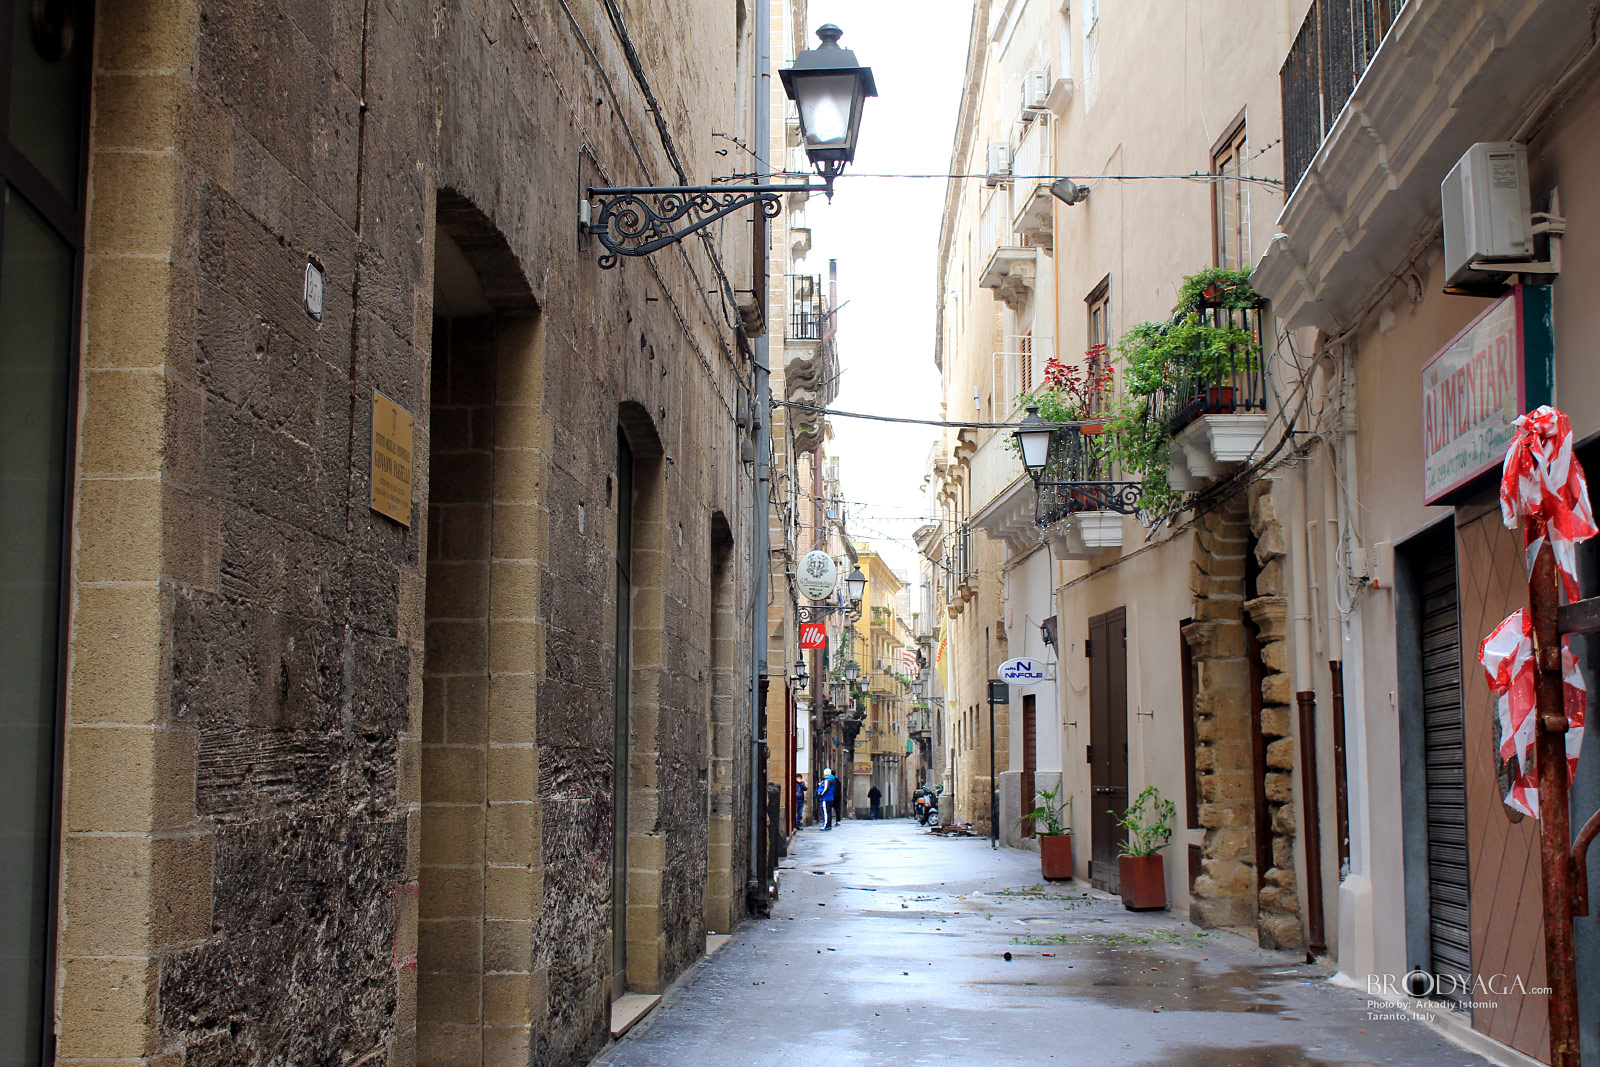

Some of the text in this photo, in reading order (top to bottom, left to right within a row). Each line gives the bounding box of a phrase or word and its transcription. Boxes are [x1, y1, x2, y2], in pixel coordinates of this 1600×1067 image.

[1425, 327, 1514, 460] ALIMENTARI
[802, 627, 825, 647] illy
[1016, 661, 1031, 671] N
